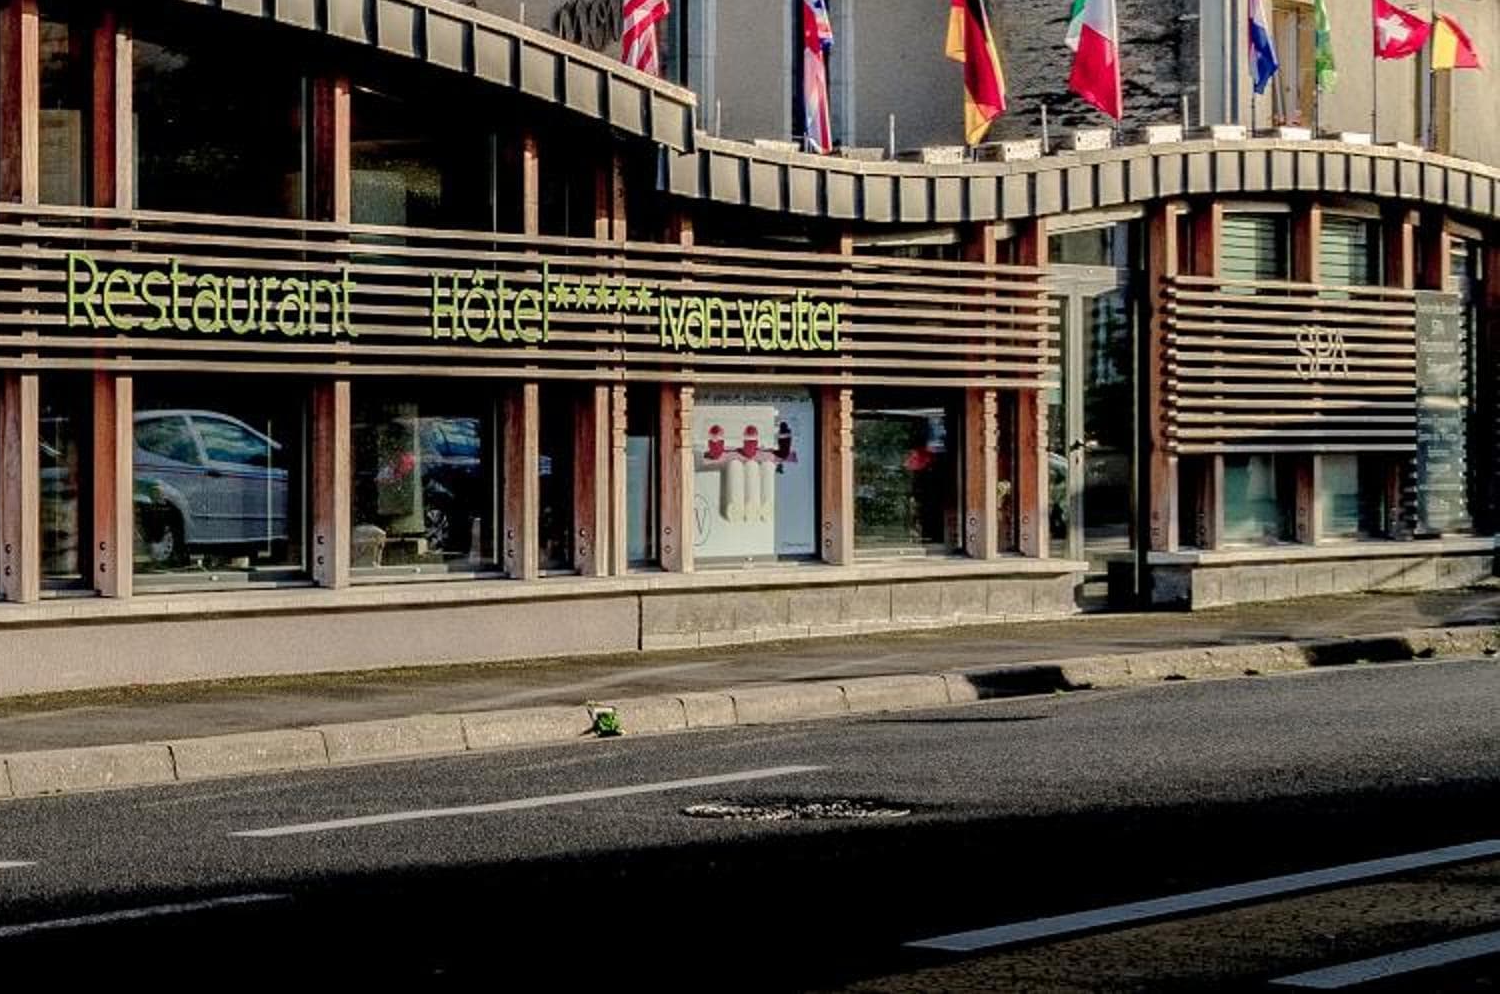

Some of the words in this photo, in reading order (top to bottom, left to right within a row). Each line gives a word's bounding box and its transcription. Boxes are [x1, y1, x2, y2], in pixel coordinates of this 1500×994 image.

[67, 252, 358, 336] Restaurant
[431, 259, 549, 343] Hôtel
[659, 283, 729, 351] ivan
[739, 288, 845, 352] vautier
[1296, 325, 1349, 380] SPA
